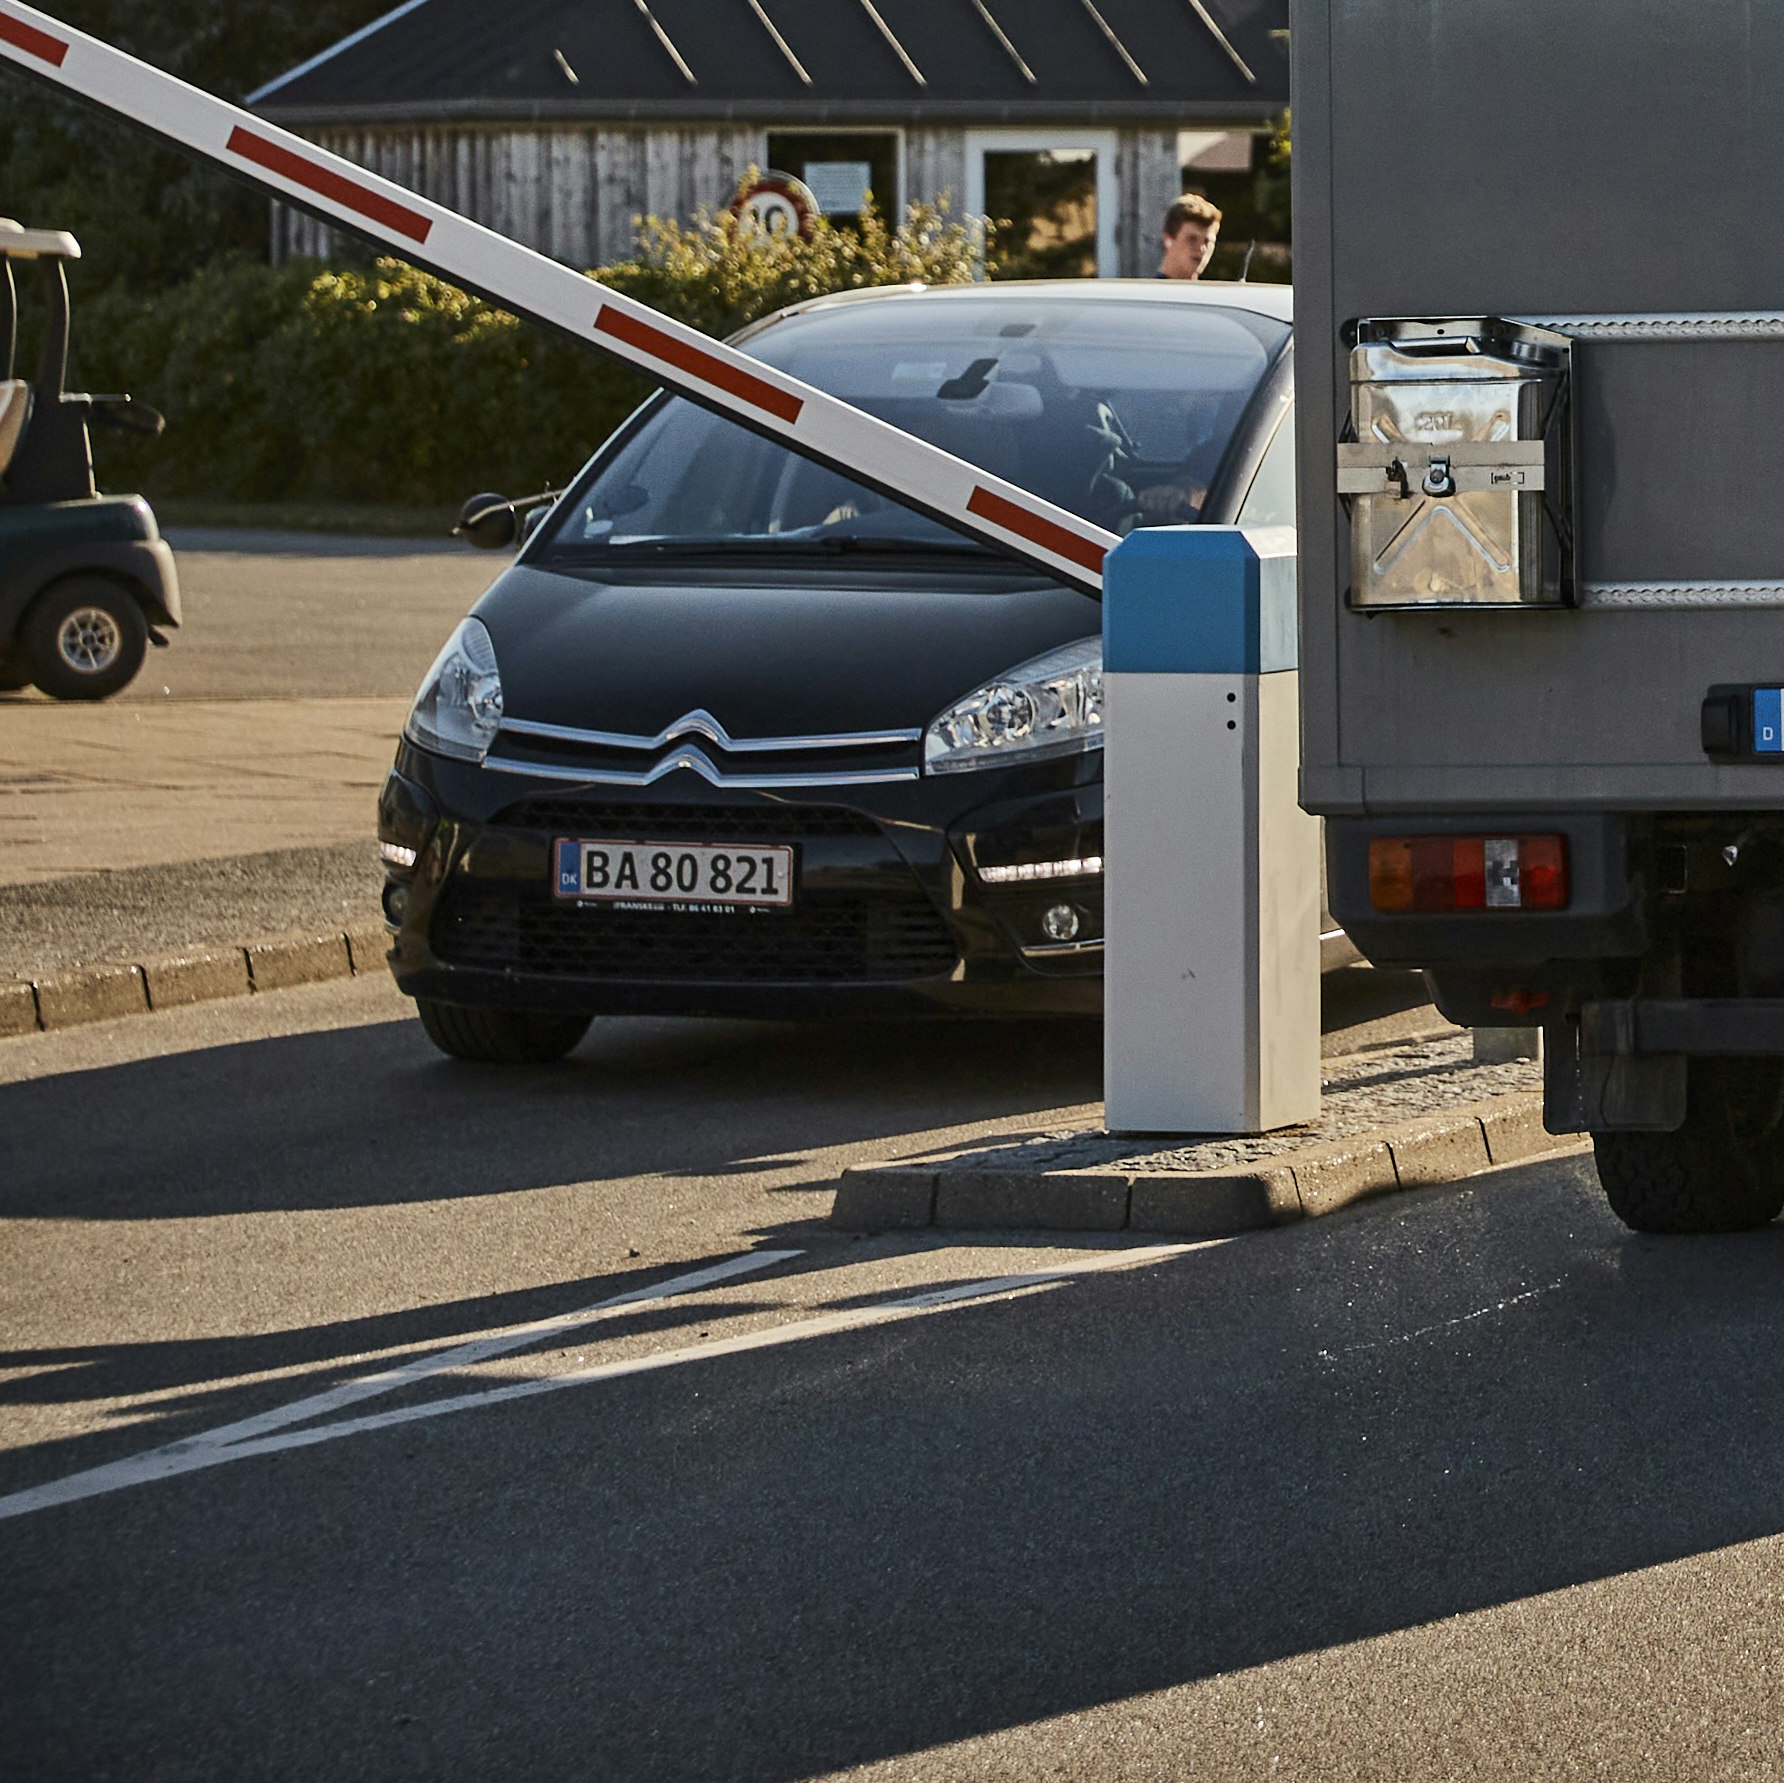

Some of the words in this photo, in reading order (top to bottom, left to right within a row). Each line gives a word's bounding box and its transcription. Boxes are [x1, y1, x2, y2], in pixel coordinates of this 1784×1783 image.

[1762, 727, 1774, 741] D
[561, 872, 577, 885] DK
[586, 850, 639, 890] BA
[650, 851, 699, 892] 80
[709, 853, 779, 896] 821
